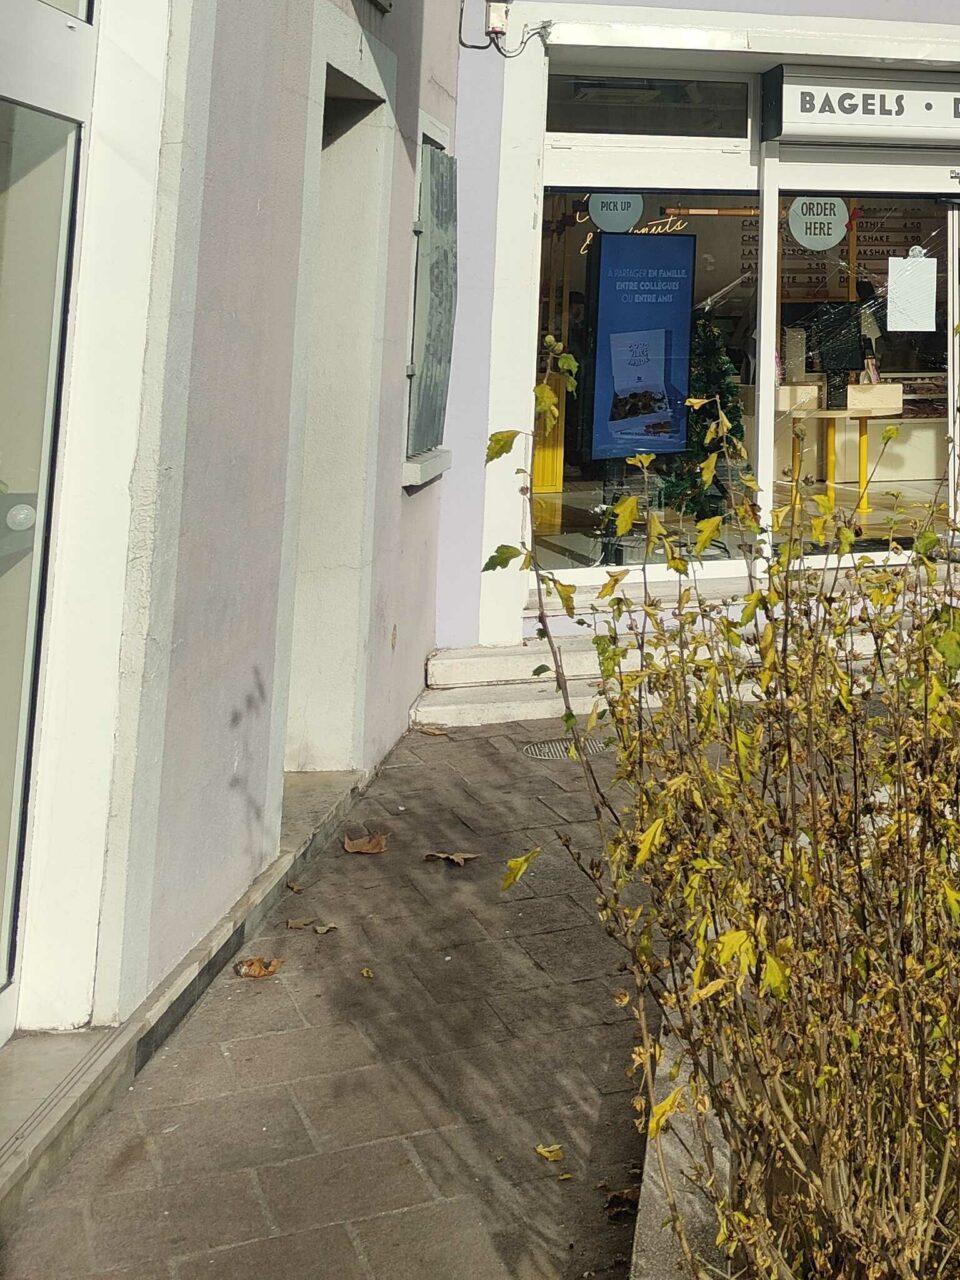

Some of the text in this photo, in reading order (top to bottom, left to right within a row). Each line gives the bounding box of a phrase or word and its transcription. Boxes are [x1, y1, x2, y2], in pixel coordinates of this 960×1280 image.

[800, 92, 906, 117] BAGELS
[600, 201, 632, 212] PICK UP
[801, 202, 837, 217] ORDER
[804, 222, 833, 236] HERE
[616, 281, 638, 290] ENTRE
[634, 294, 657, 303] ENTRE
